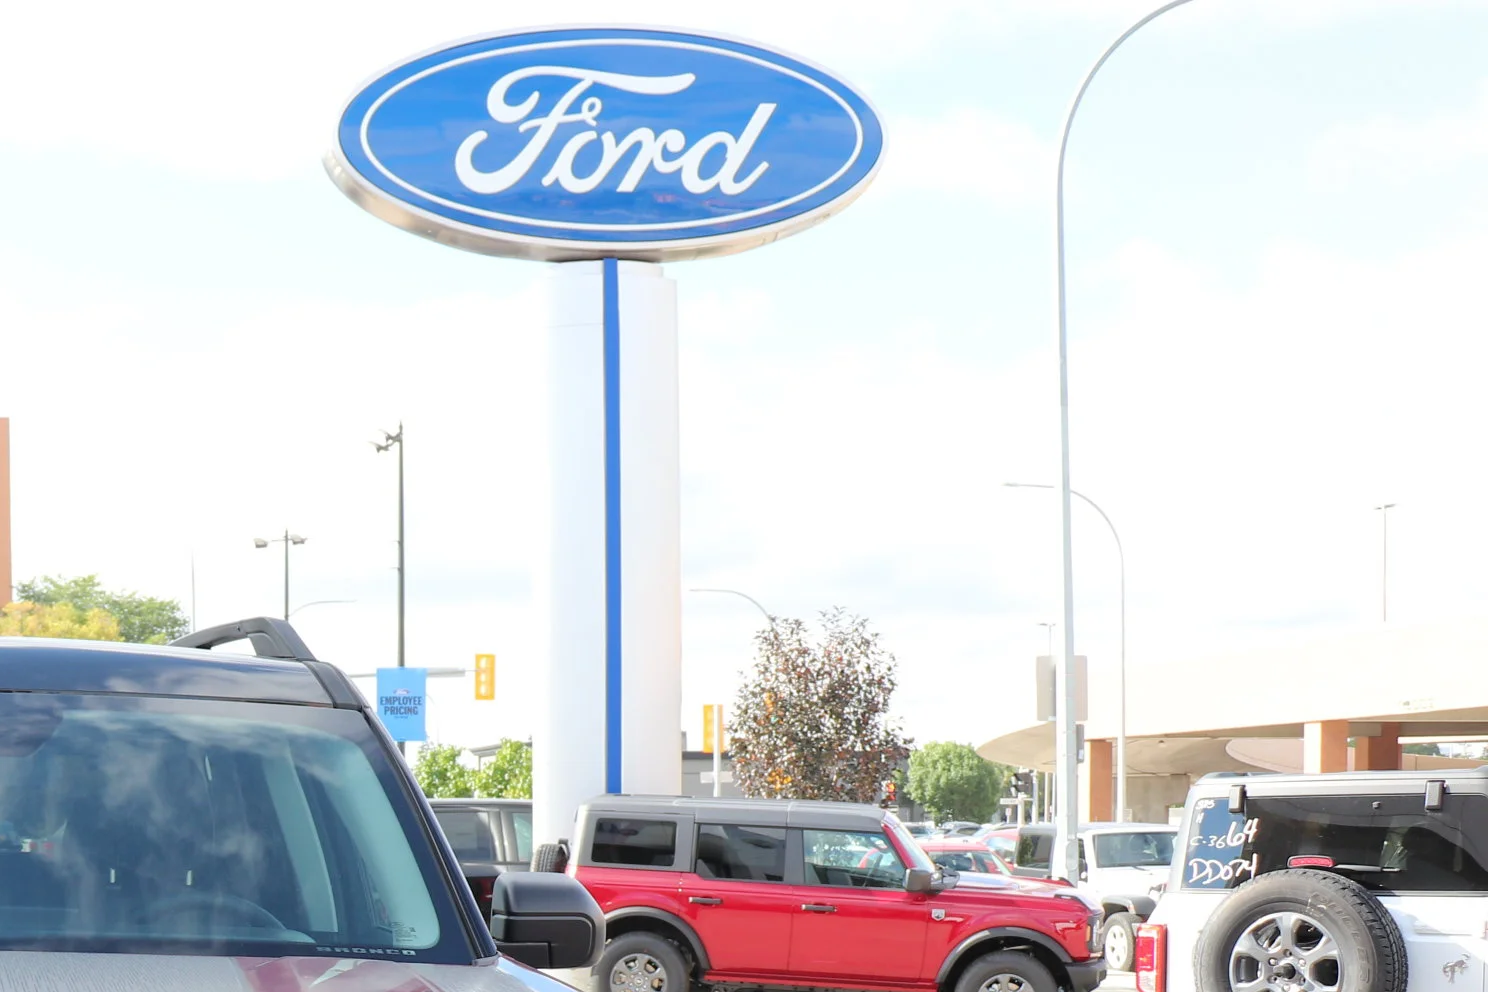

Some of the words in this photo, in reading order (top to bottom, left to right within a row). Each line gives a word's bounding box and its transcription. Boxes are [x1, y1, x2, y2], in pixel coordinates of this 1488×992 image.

[454, 65, 777, 195] Ford
[380, 696, 422, 706] EMPLOYEE
[384, 706, 418, 716] PRICING
[316, 946, 416, 956] BRONCO
